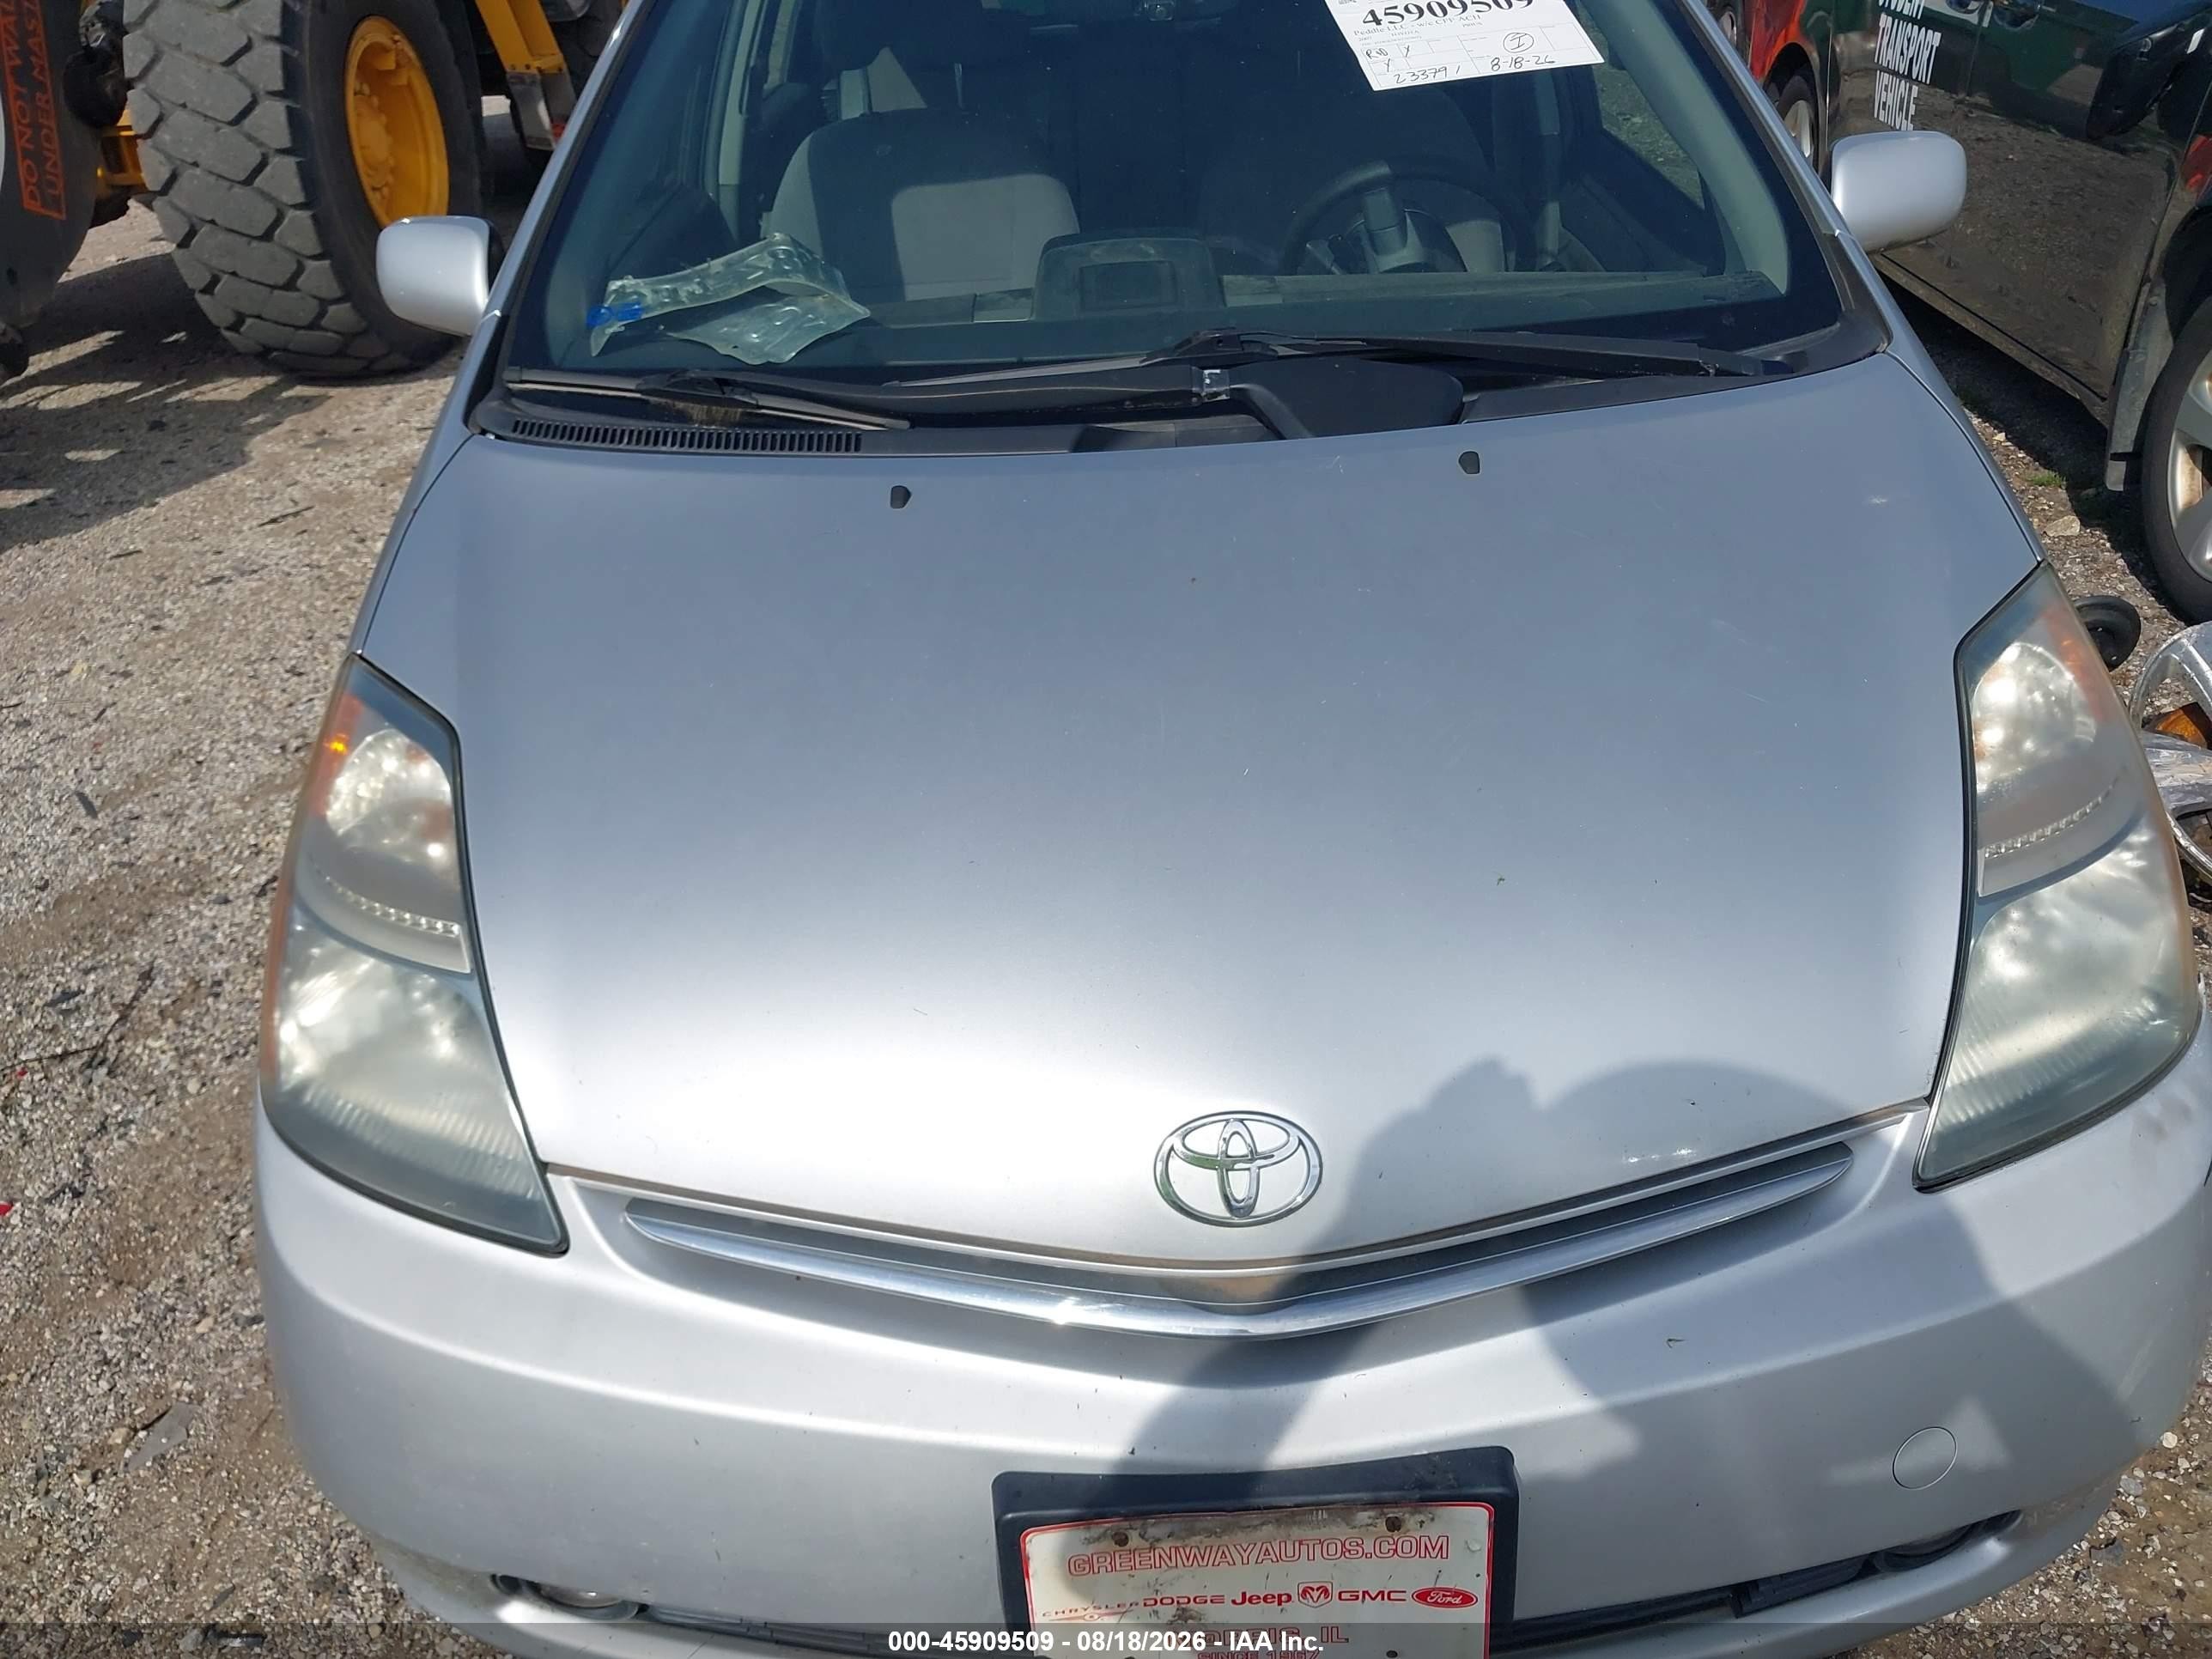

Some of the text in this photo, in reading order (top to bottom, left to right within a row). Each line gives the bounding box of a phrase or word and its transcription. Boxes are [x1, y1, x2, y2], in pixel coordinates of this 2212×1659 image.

[1875, 11, 1942, 84] TRANSPORT
[13, 83, 35, 150] NOT
[1874, 70, 1919, 131] VEHICLE
[35, 90, 61, 195] UNDER
[25, 157, 42, 207] DO
[1067, 1534, 1449, 1577] GREENWAYAUTOS.COM
[1042, 1590, 1463, 1618] CHRYSLER DODGE Jeep GMC Ford
[1321, 1626, 1350, 1644] IL
